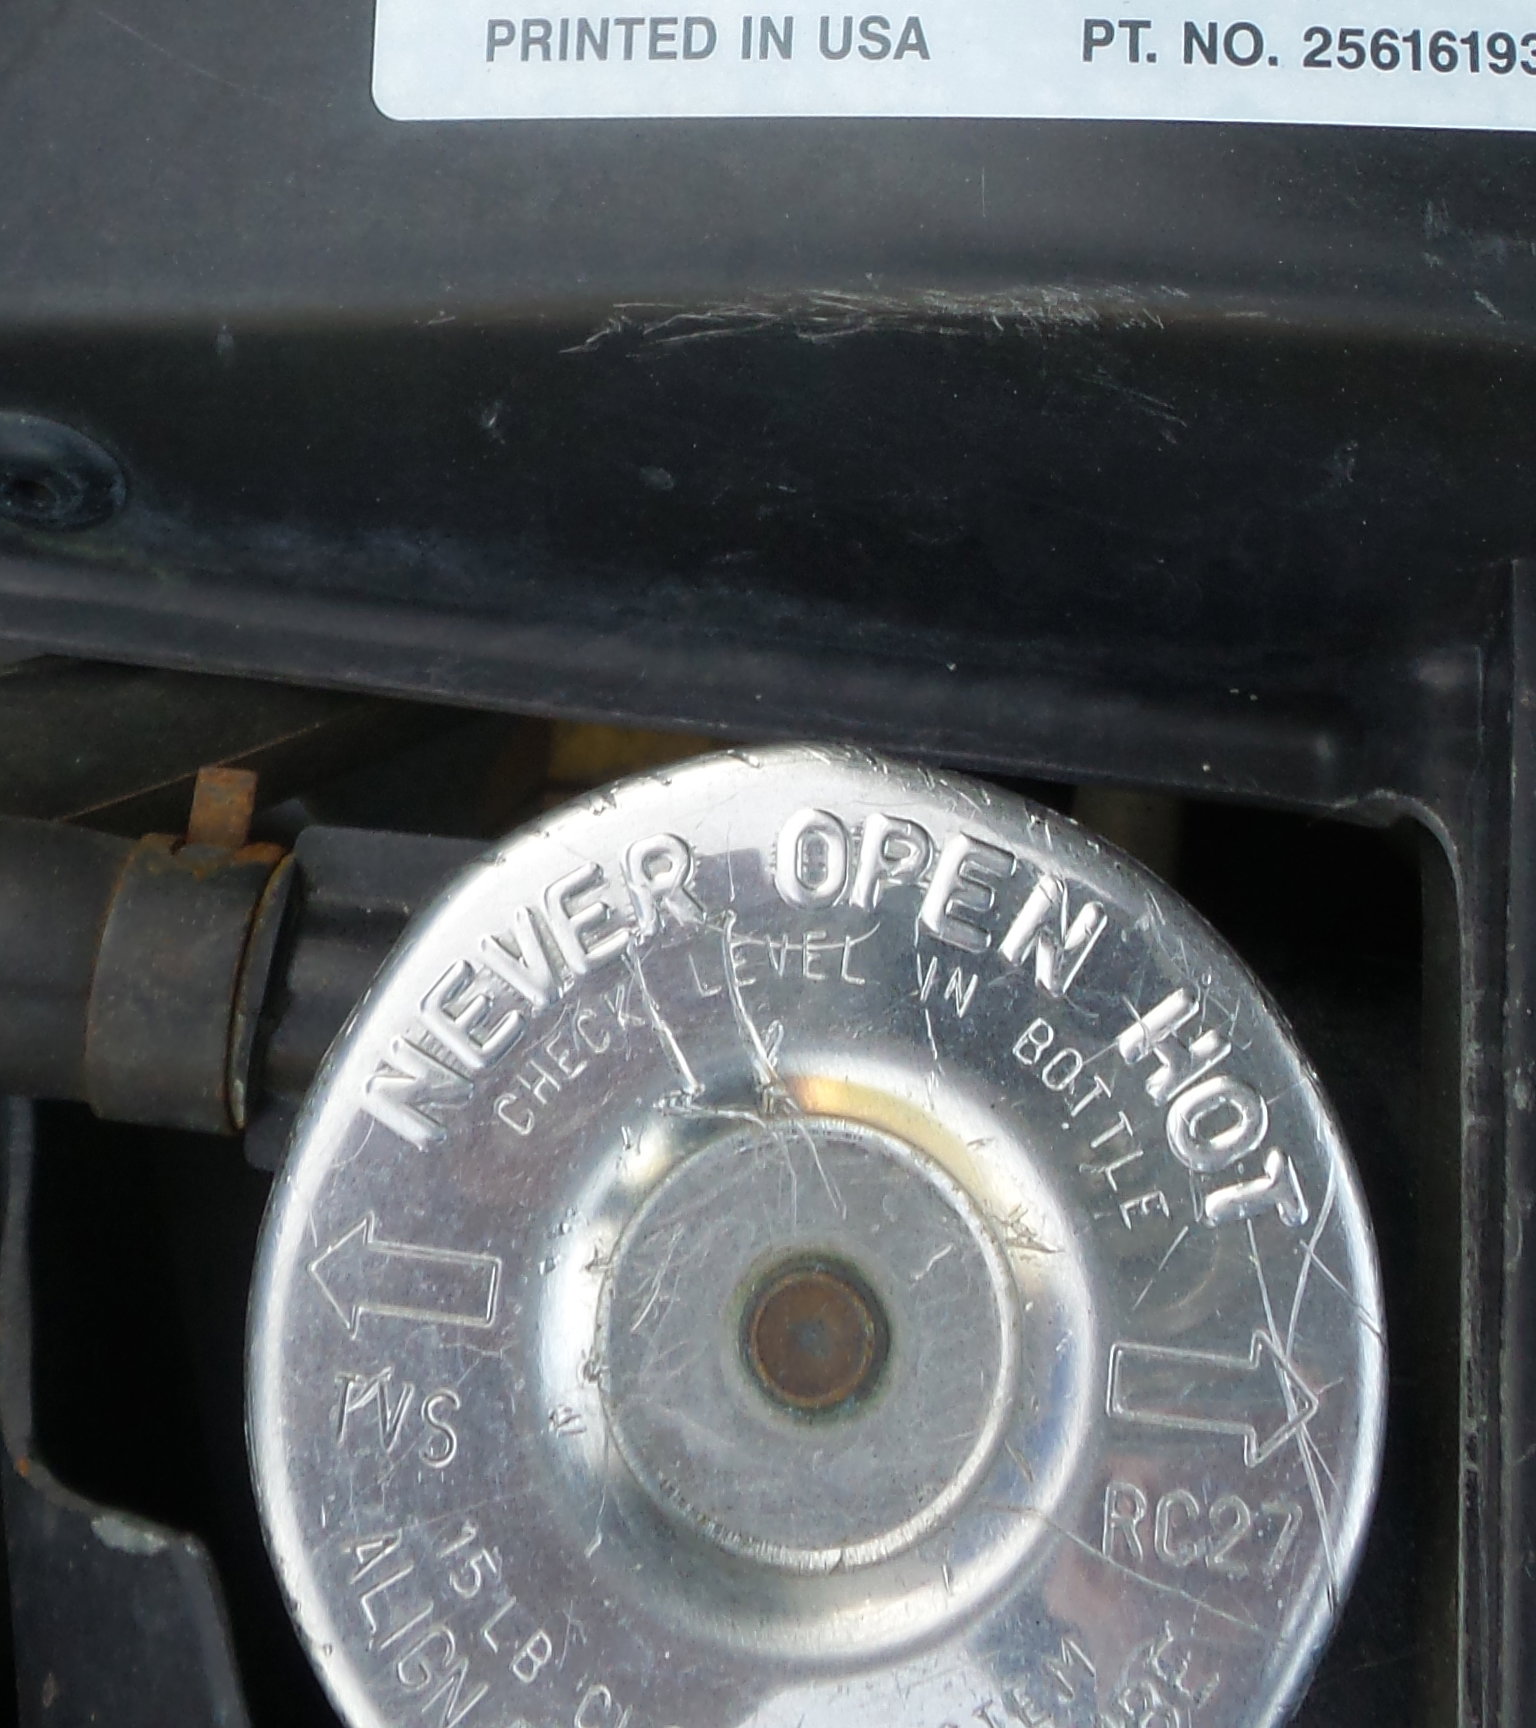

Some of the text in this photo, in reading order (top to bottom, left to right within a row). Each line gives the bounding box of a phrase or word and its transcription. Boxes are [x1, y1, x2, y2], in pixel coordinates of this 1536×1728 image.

[486, 15, 931, 63] PRINTED IN USA
[1082, 18, 1157, 64] PT.
[1183, 21, 1279, 67] NO.
[364, 807, 1310, 1230] NEVER OPEN HOT
[493, 929, 1172, 1232] CHECK LEVEL IN BOTTLE
[1102, 1480, 1304, 1582] RC27
[341, 1525, 490, 1728] ALIGN
